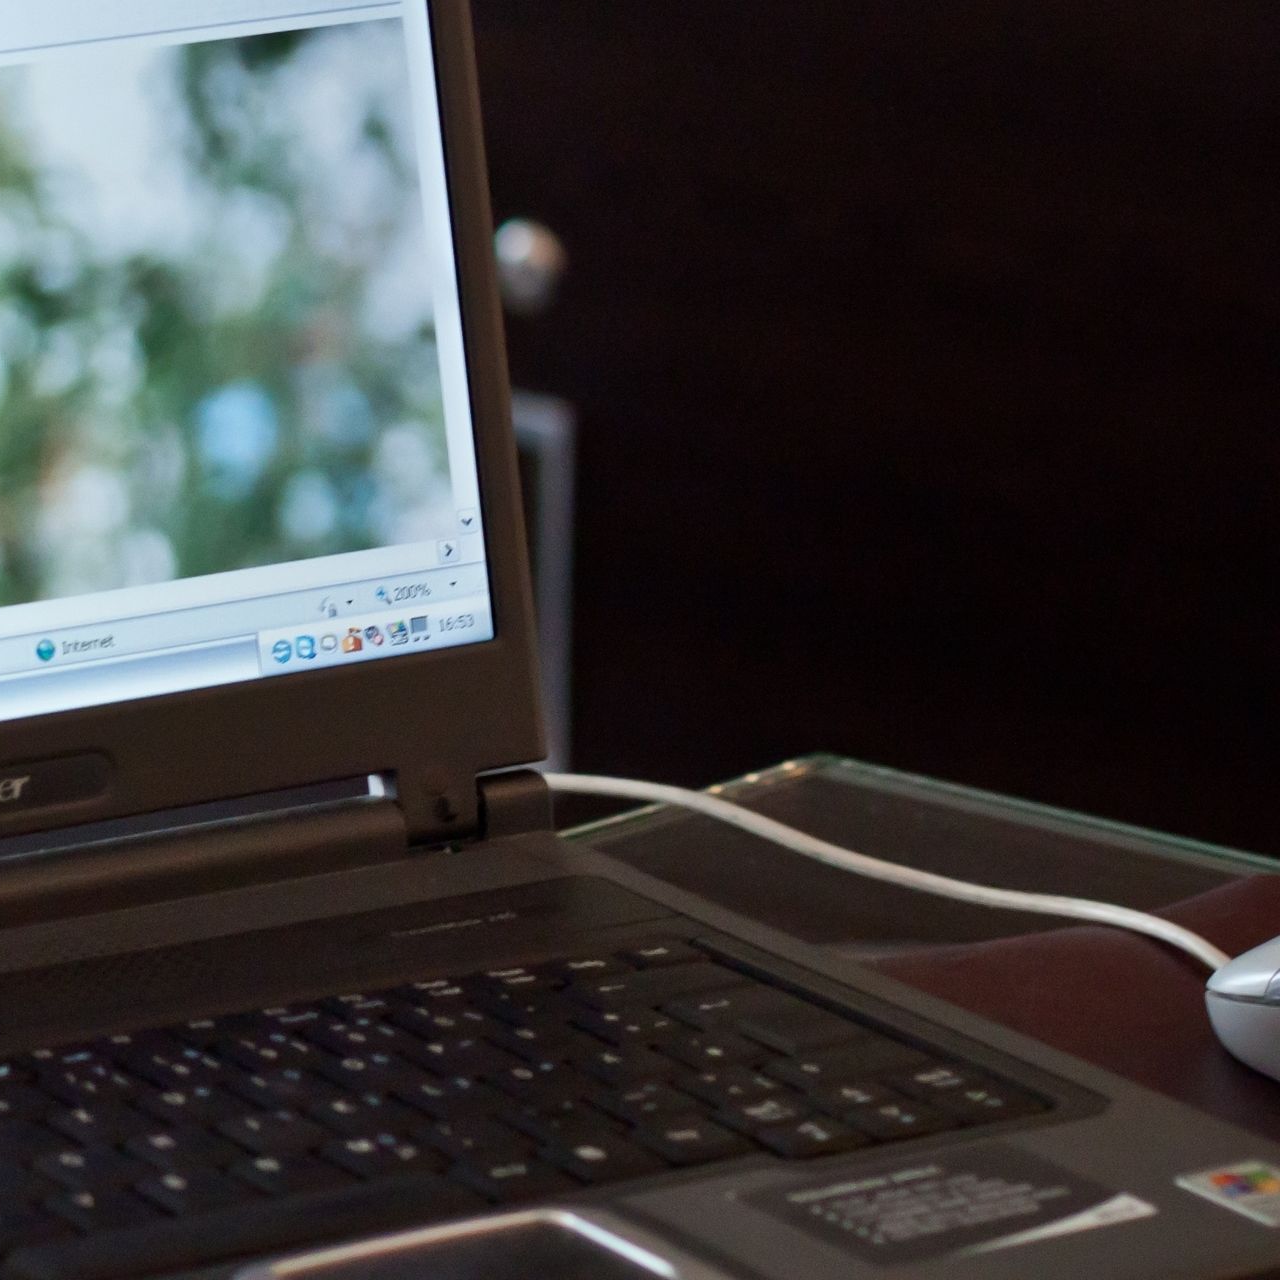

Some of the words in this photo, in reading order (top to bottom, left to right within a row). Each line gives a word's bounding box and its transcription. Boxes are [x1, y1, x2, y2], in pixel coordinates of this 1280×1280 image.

[392, 581, 433, 603] 200%
[439, 612, 476, 634] 16:53
[61, 632, 116, 657] Internet
